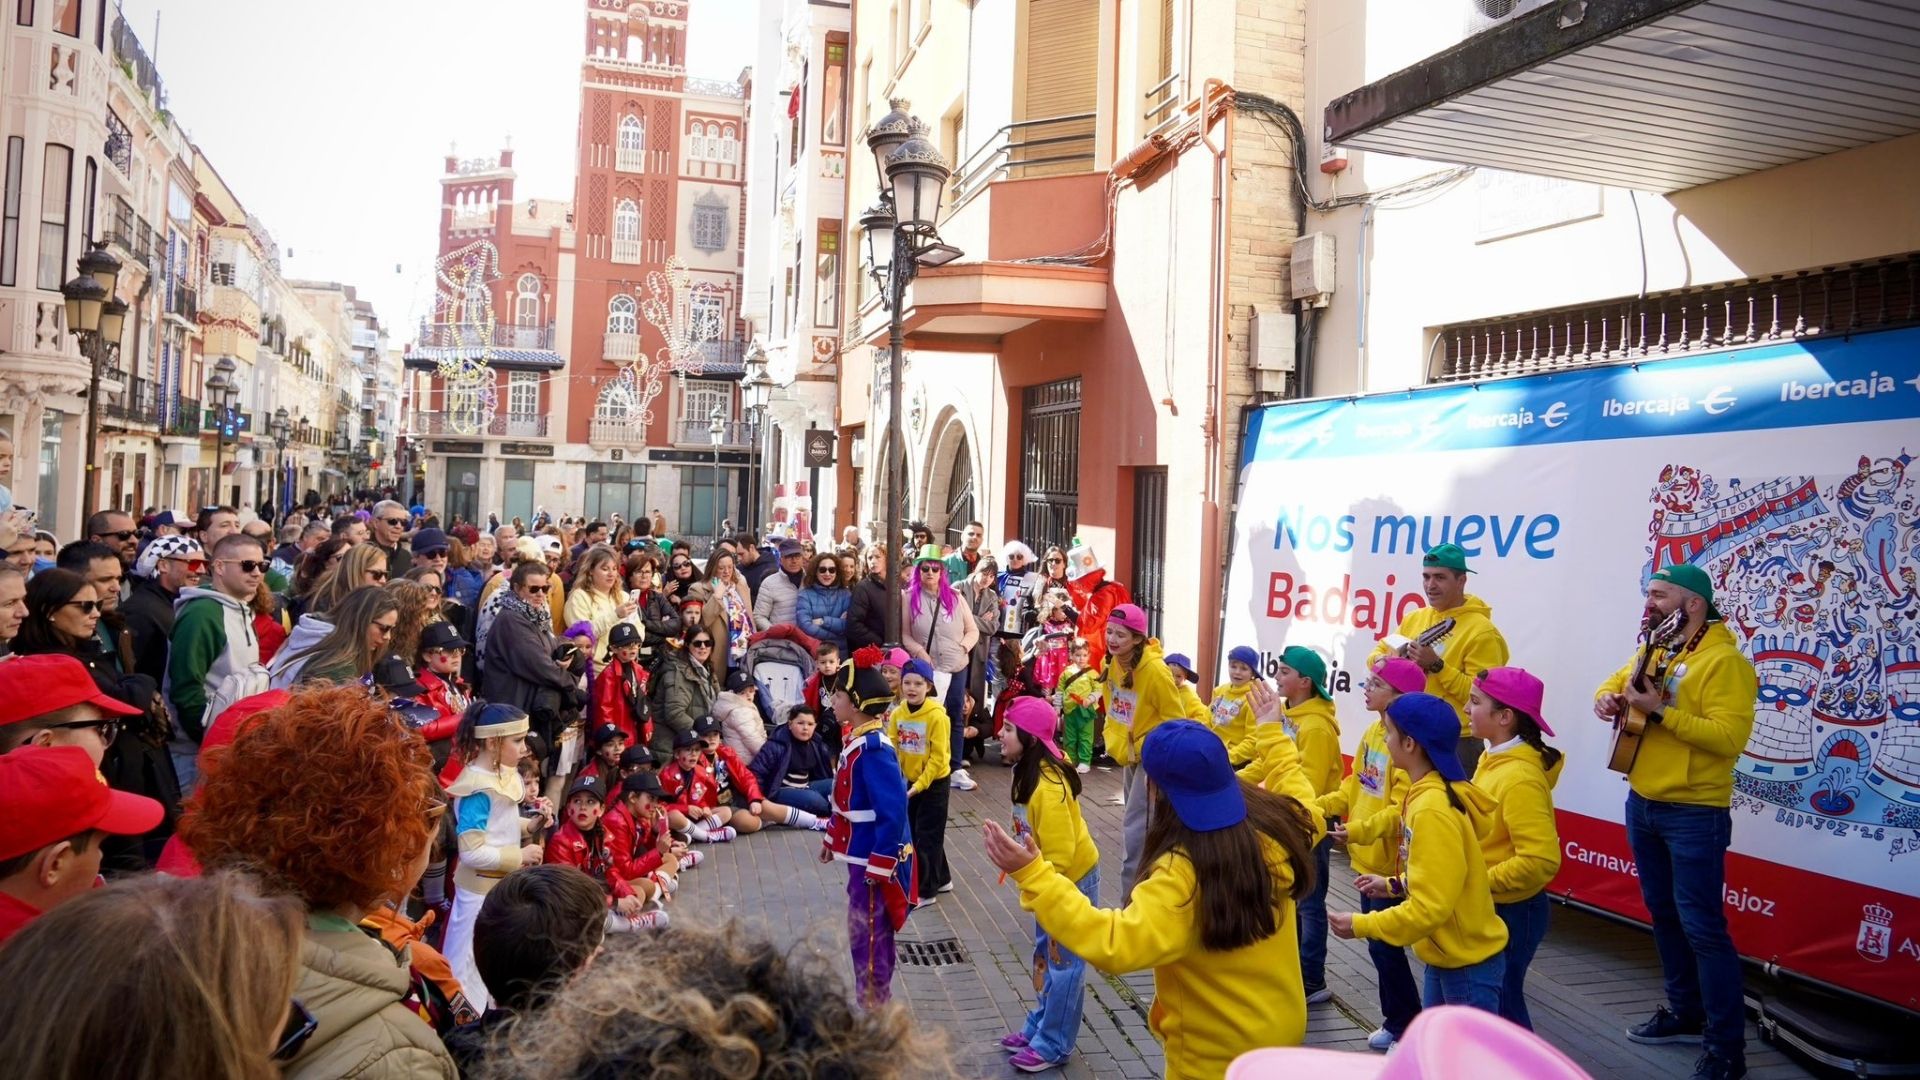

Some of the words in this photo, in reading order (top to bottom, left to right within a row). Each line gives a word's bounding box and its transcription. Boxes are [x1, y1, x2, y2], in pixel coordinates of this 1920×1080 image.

[1602, 392, 1690, 417] Ibercaja
[1780, 371, 1896, 402] Ibercaja
[1273, 503, 1356, 553] Nos
[1371, 512, 1561, 560] mueve
[1266, 571, 1428, 641] Badajo
[1260, 651, 1351, 696] Ibja
[1775, 808, 1848, 837] BADAJOZ
[1565, 841, 1640, 877] Carnava
[1722, 881, 1776, 917] ajoz
